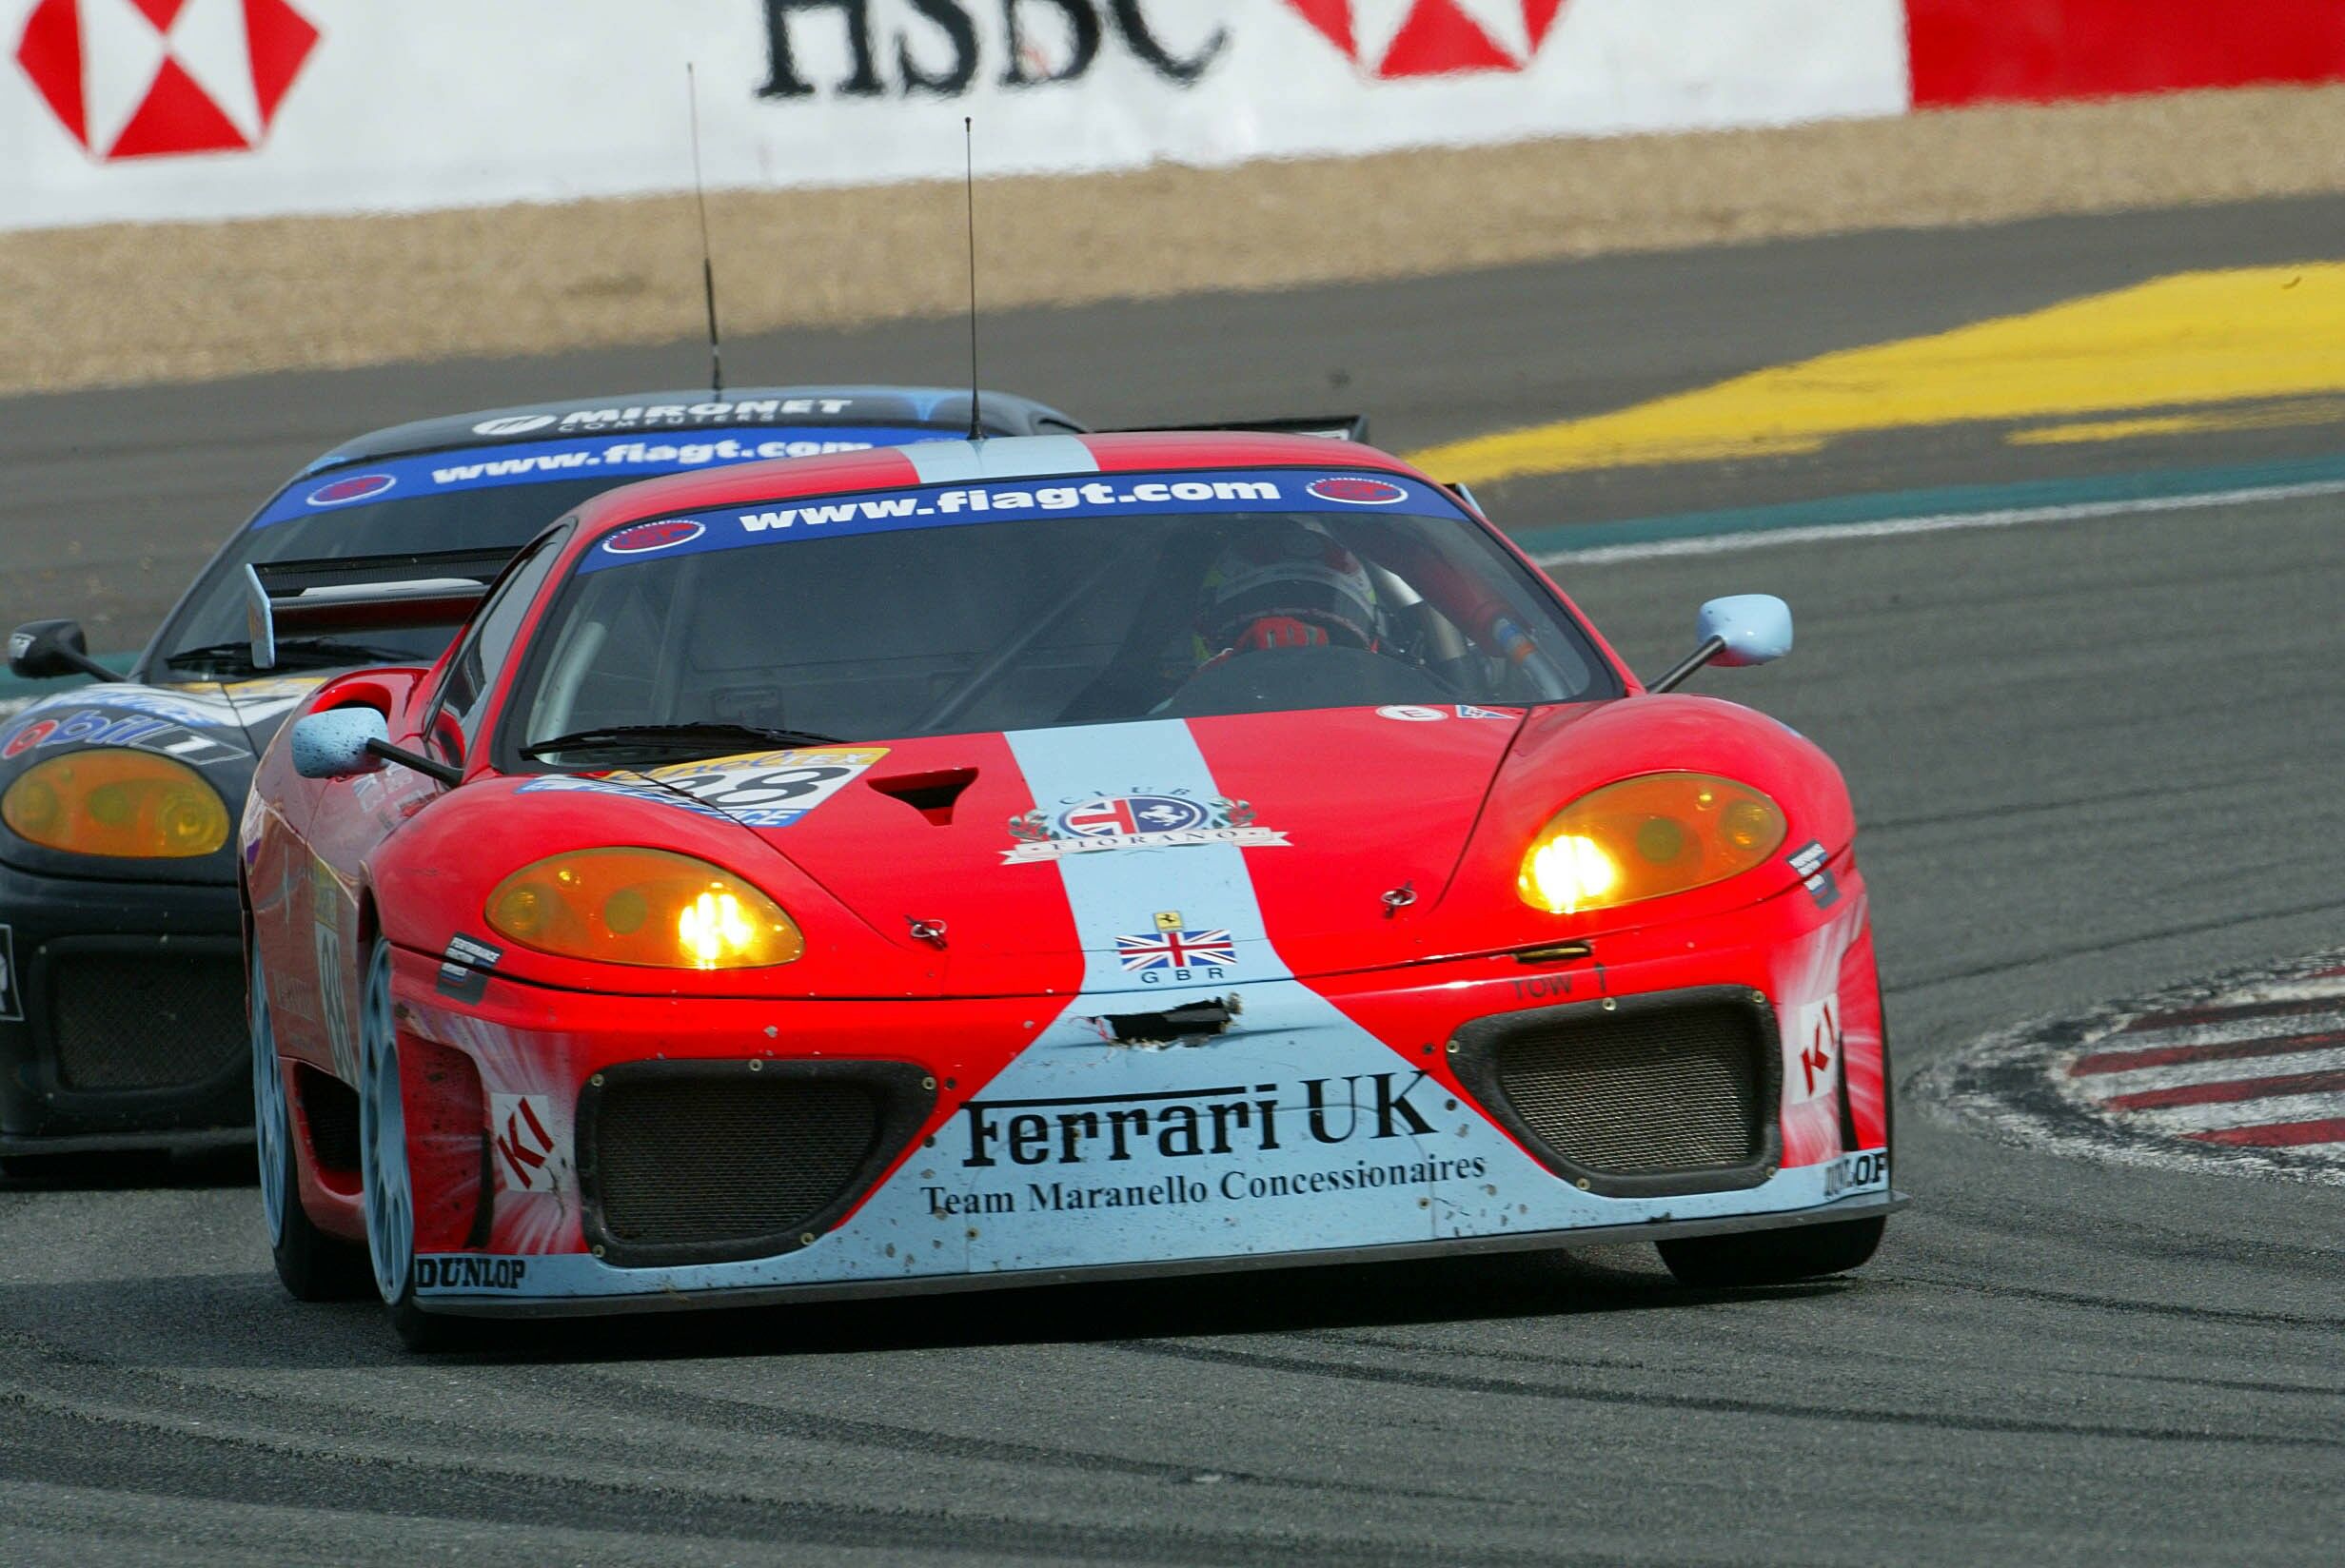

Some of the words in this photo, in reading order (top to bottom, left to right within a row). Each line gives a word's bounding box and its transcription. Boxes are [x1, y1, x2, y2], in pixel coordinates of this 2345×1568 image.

[557, 412, 776, 434] COMPUTERS
[562, 399, 854, 424] MIRONET
[433, 440, 874, 485] www.fiagt.com
[739, 479, 1282, 533] www.fiagt.com
[0, 710, 175, 760] obil
[1058, 786, 1192, 806] CLUB
[1053, 830, 1238, 851] FIORANO
[1509, 974, 1573, 1001] TOW
[958, 1083, 1280, 1168] Ferrari
[1303, 1069, 1439, 1144] UK
[920, 1186, 1015, 1216] Team
[1028, 1175, 1208, 1213] Maranello
[1220, 1153, 1487, 1201] Concessionaires
[415, 1257, 526, 1289] DUNLOP
